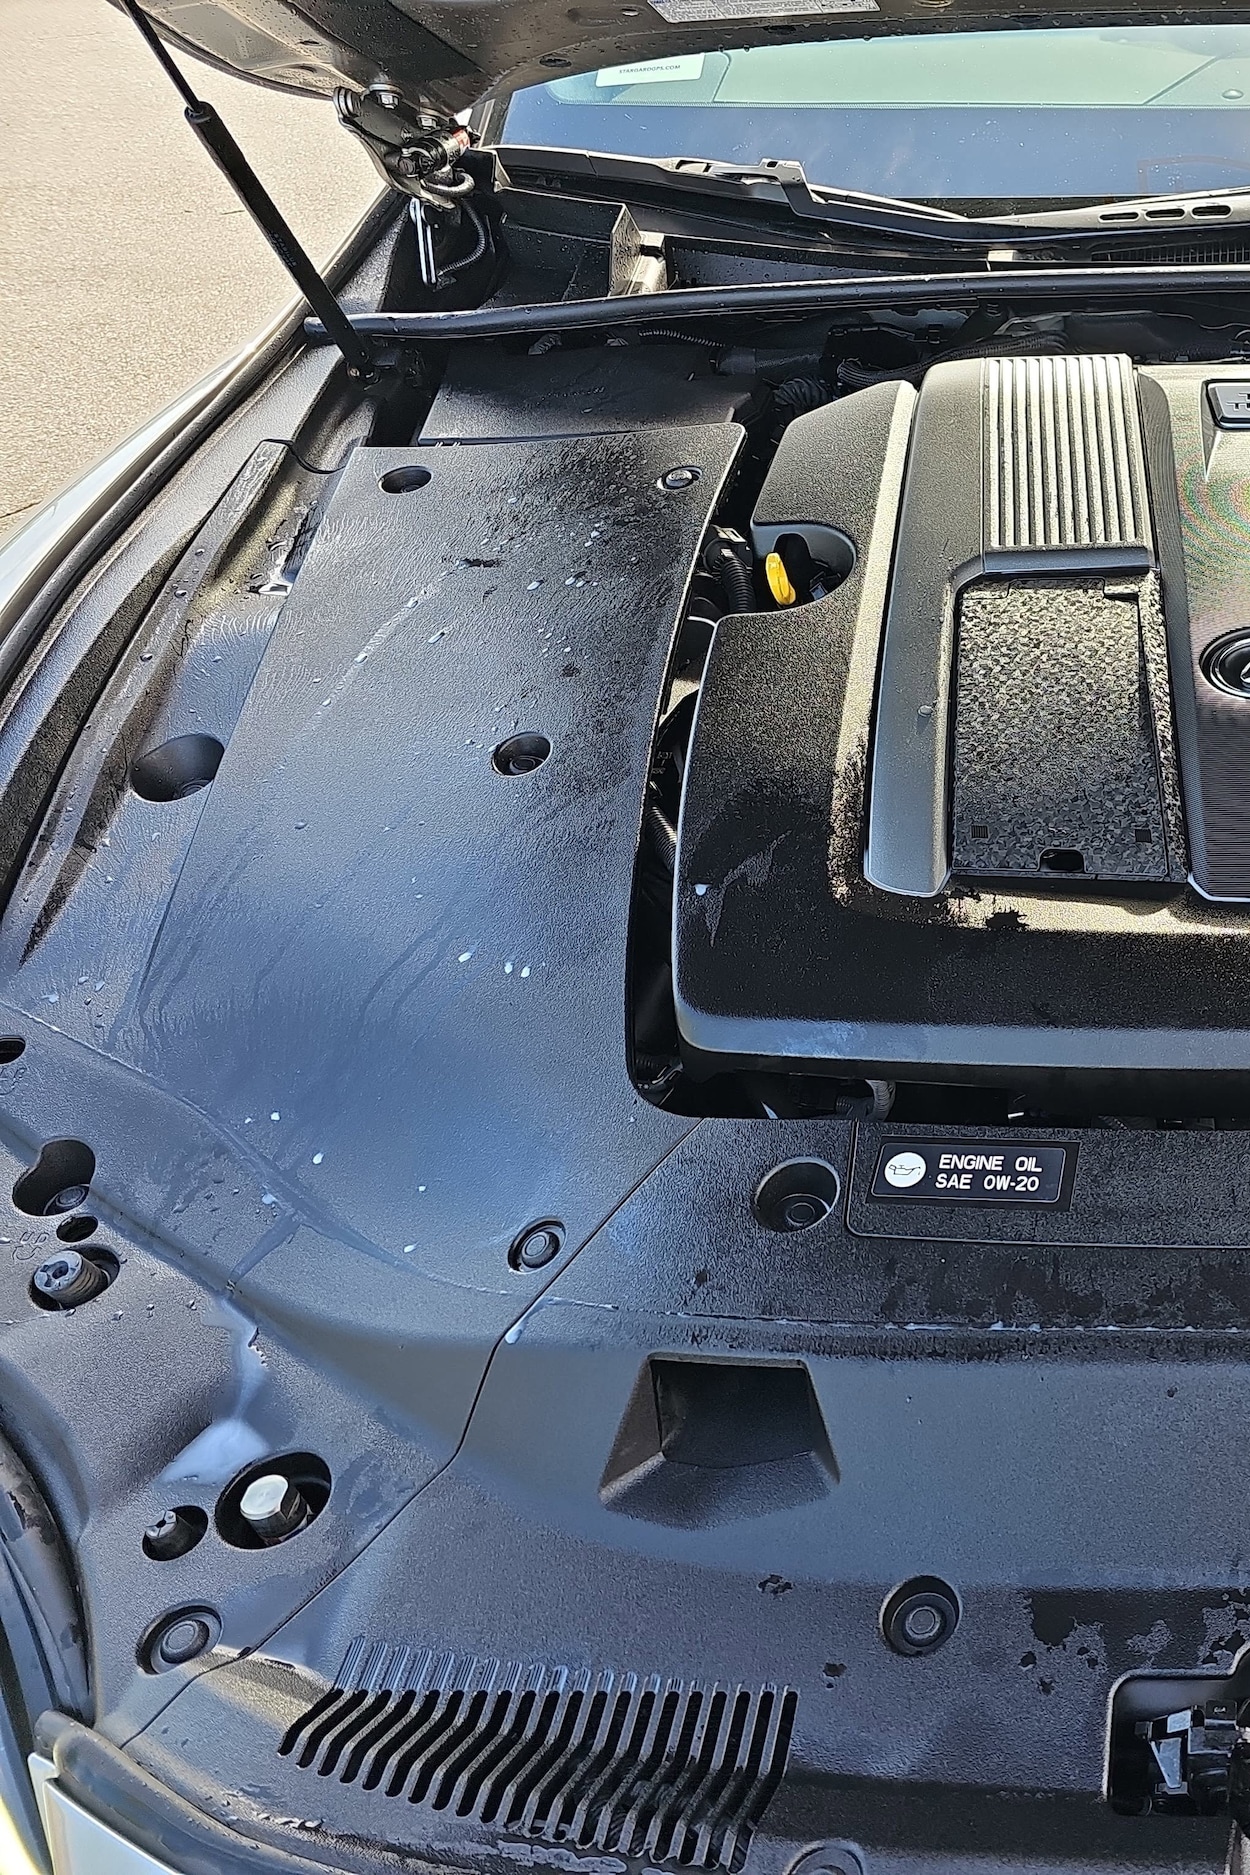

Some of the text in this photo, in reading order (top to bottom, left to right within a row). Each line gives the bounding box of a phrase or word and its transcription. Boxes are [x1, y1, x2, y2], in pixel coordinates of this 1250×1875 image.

[938, 1153, 1043, 1173] ENGINE OIL
[935, 1173, 1040, 1192] SAE 0W-20
